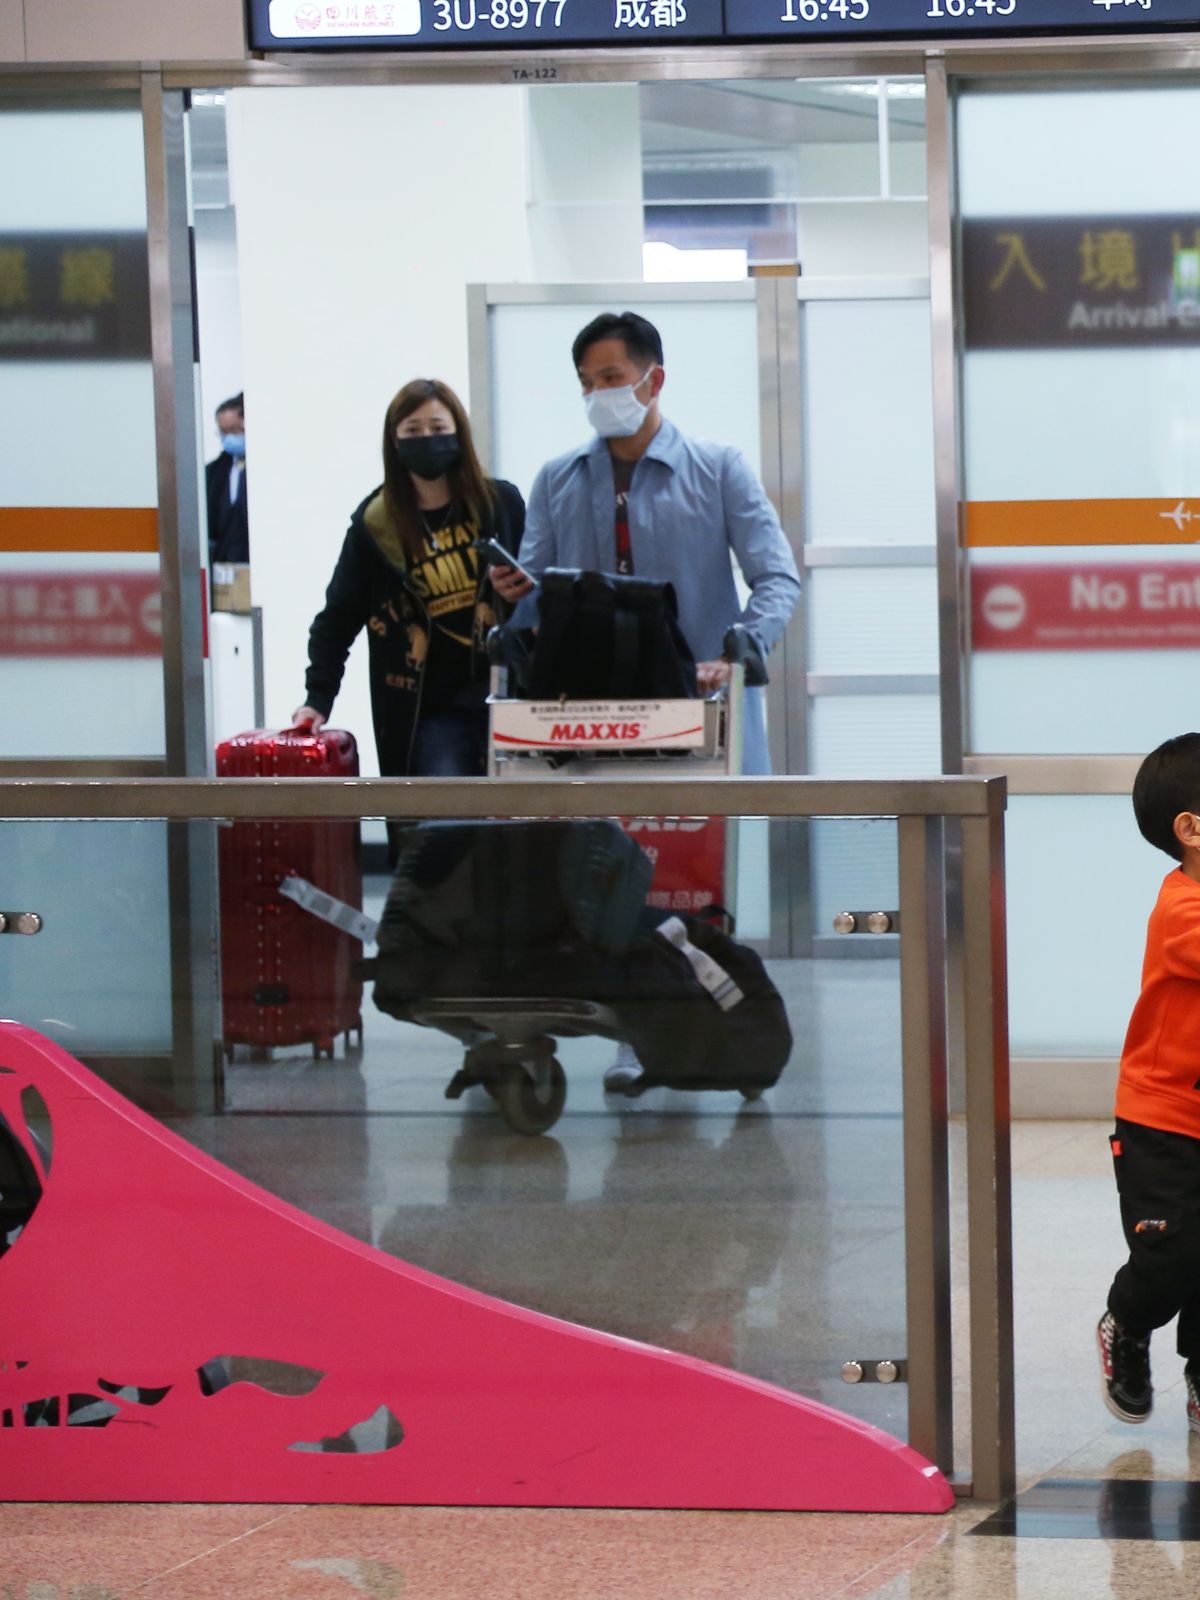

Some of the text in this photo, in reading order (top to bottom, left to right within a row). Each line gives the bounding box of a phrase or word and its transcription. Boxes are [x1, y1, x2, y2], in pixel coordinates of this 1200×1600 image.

[433, 0, 568, 30] 3U-8977
[614, 0, 688, 28] 成都
[780, 0, 870, 21] 16:45
[512, 68, 557, 79] TA-122
[1070, 575, 1128, 611] No
[550, 722, 642, 741] MAXXIS
